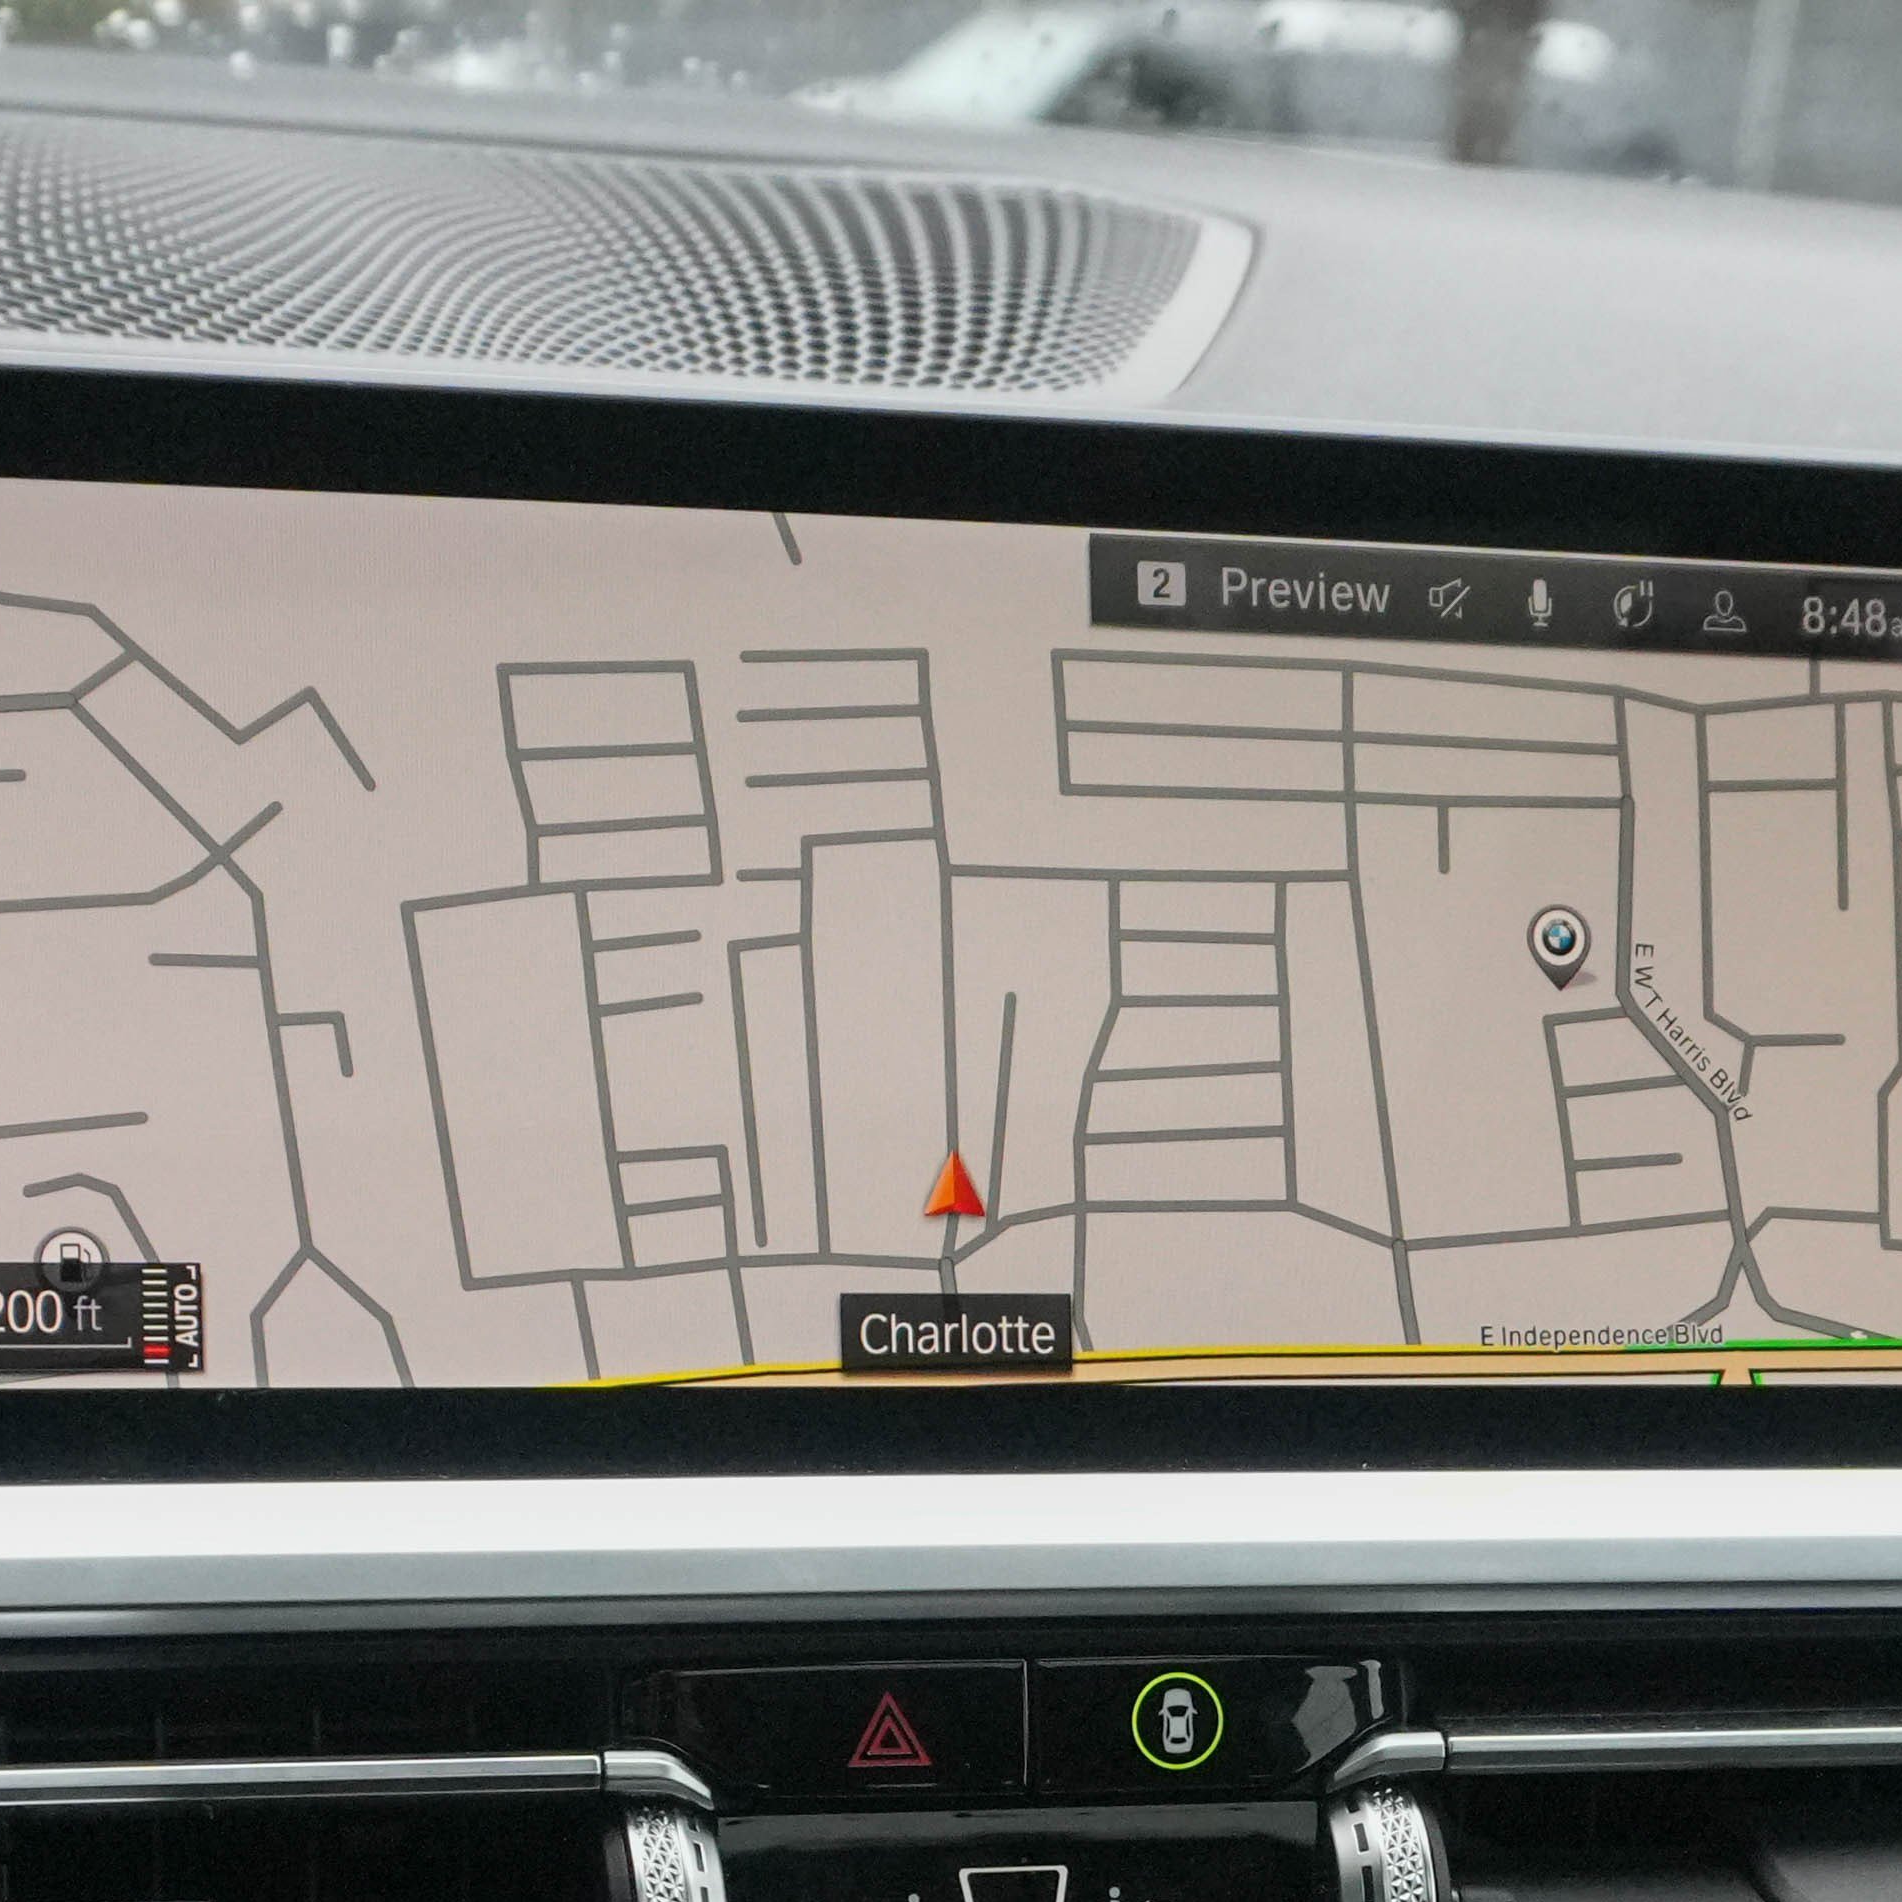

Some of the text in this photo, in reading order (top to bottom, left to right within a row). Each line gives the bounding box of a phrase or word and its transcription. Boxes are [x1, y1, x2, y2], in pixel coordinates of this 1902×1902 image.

[1151, 566, 1391, 614] 2 Preview
[1634, 942, 1655, 958] E
[1656, 1007, 1711, 1073] Harris
[1709, 1067, 1753, 1122] Blvd
[72, 1297, 103, 1332] ft
[174, 1282, 199, 1348] AUTO
[859, 1312, 1056, 1355] Charlotte
[1480, 1323, 1724, 1354] E Independence Blvd
